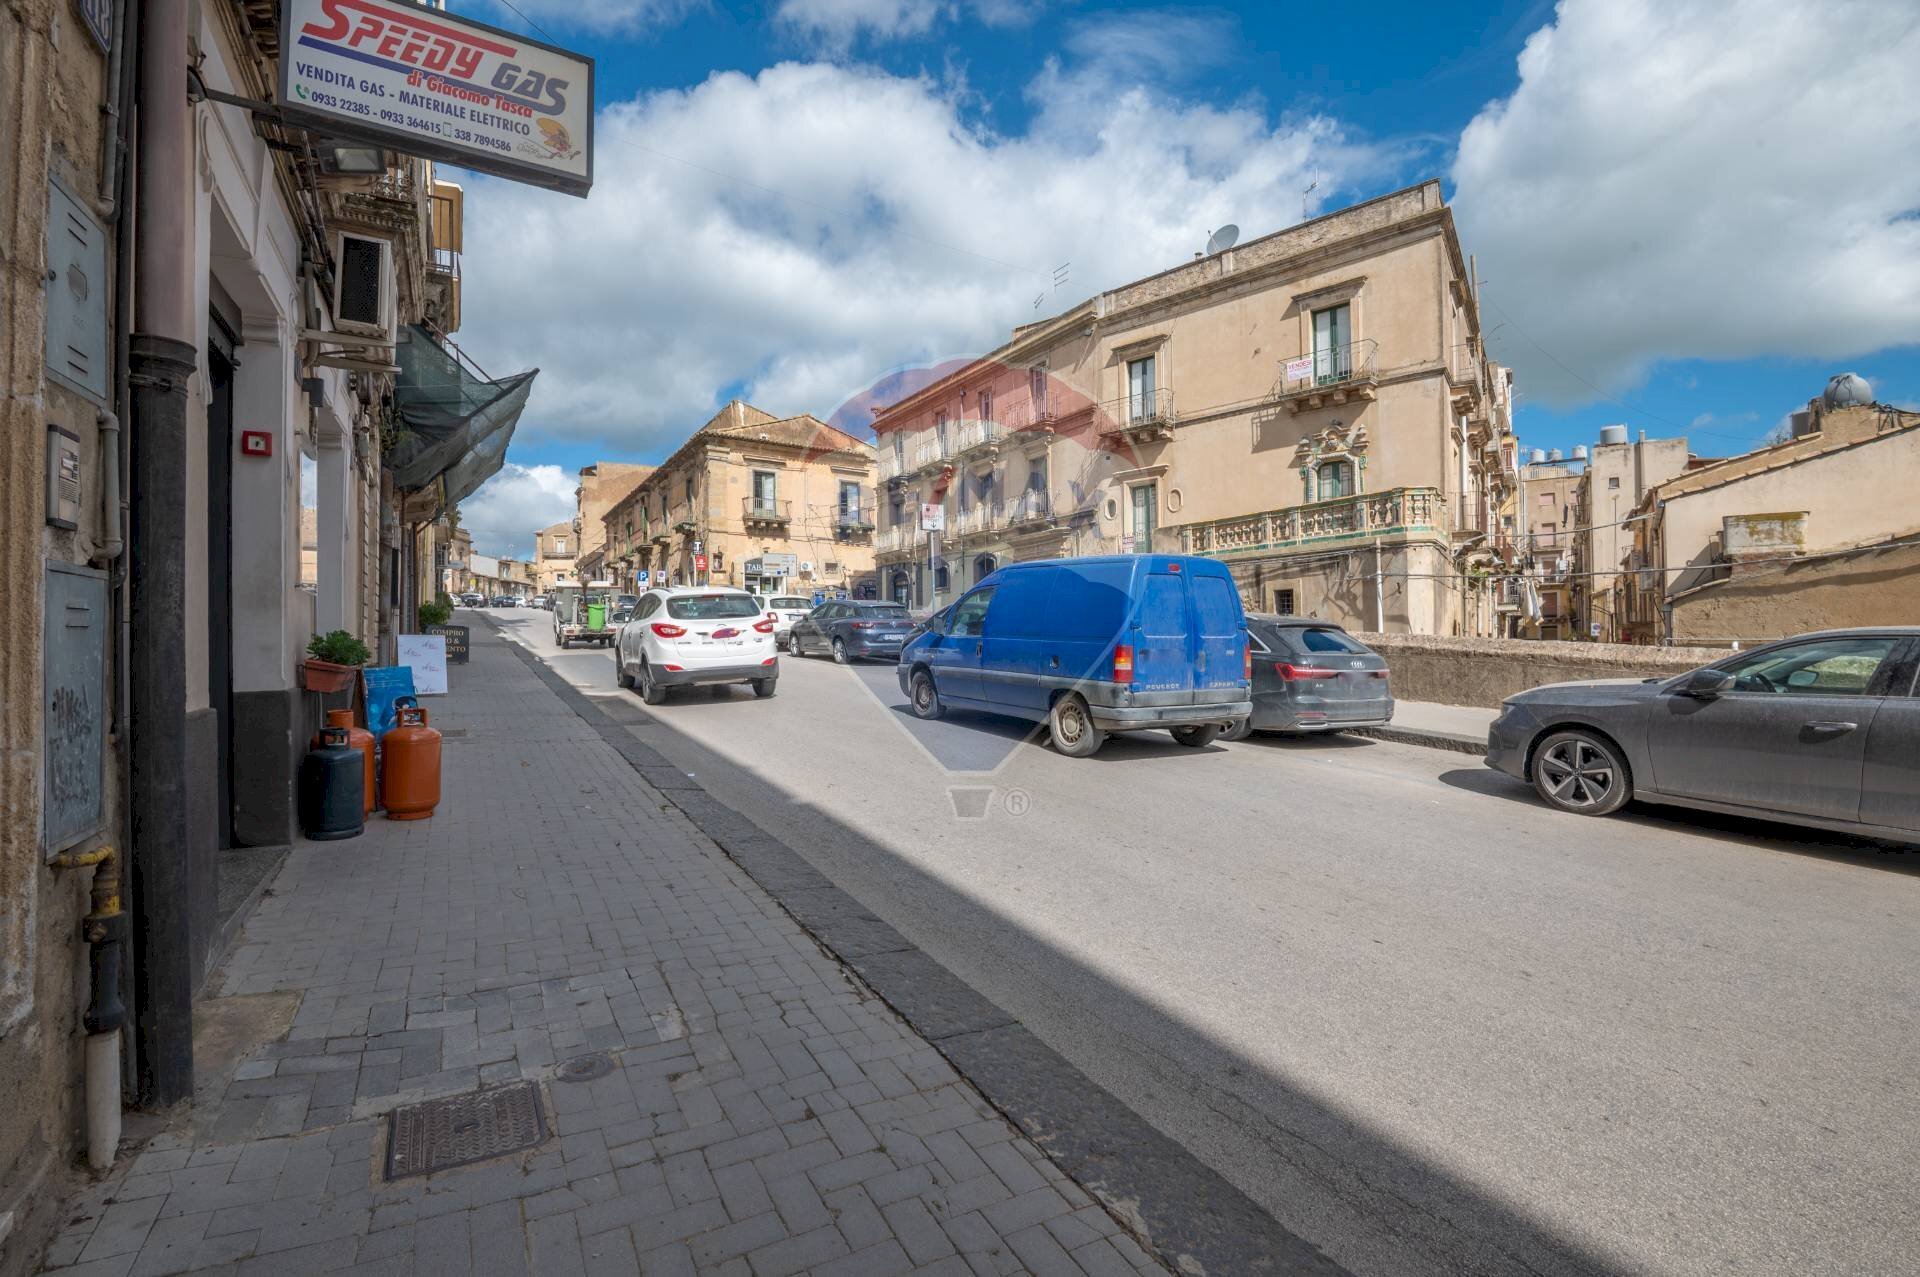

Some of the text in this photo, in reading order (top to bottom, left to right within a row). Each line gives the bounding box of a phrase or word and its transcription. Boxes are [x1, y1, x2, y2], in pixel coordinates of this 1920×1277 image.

[301, 0, 569, 116] SPEEDY GAS
[296, 61, 355, 90] VENDITA
[360, 80, 385, 98] GAS
[400, 90, 466, 119] MATERIALE
[470, 109, 530, 136] ELETTRICO
[407, 69, 534, 118] di Giacomo Tasca
[312, 91, 337, 107] 0933
[340, 98, 370, 116] 22385
[381, 109, 404, 125] 0933
[407, 117, 441, 134] 364615
[454, 128, 471, 142] 338
[474, 133, 511, 152] 7894586
[747, 563, 763, 572] TAB
[432, 629, 464, 638] COMPRO
